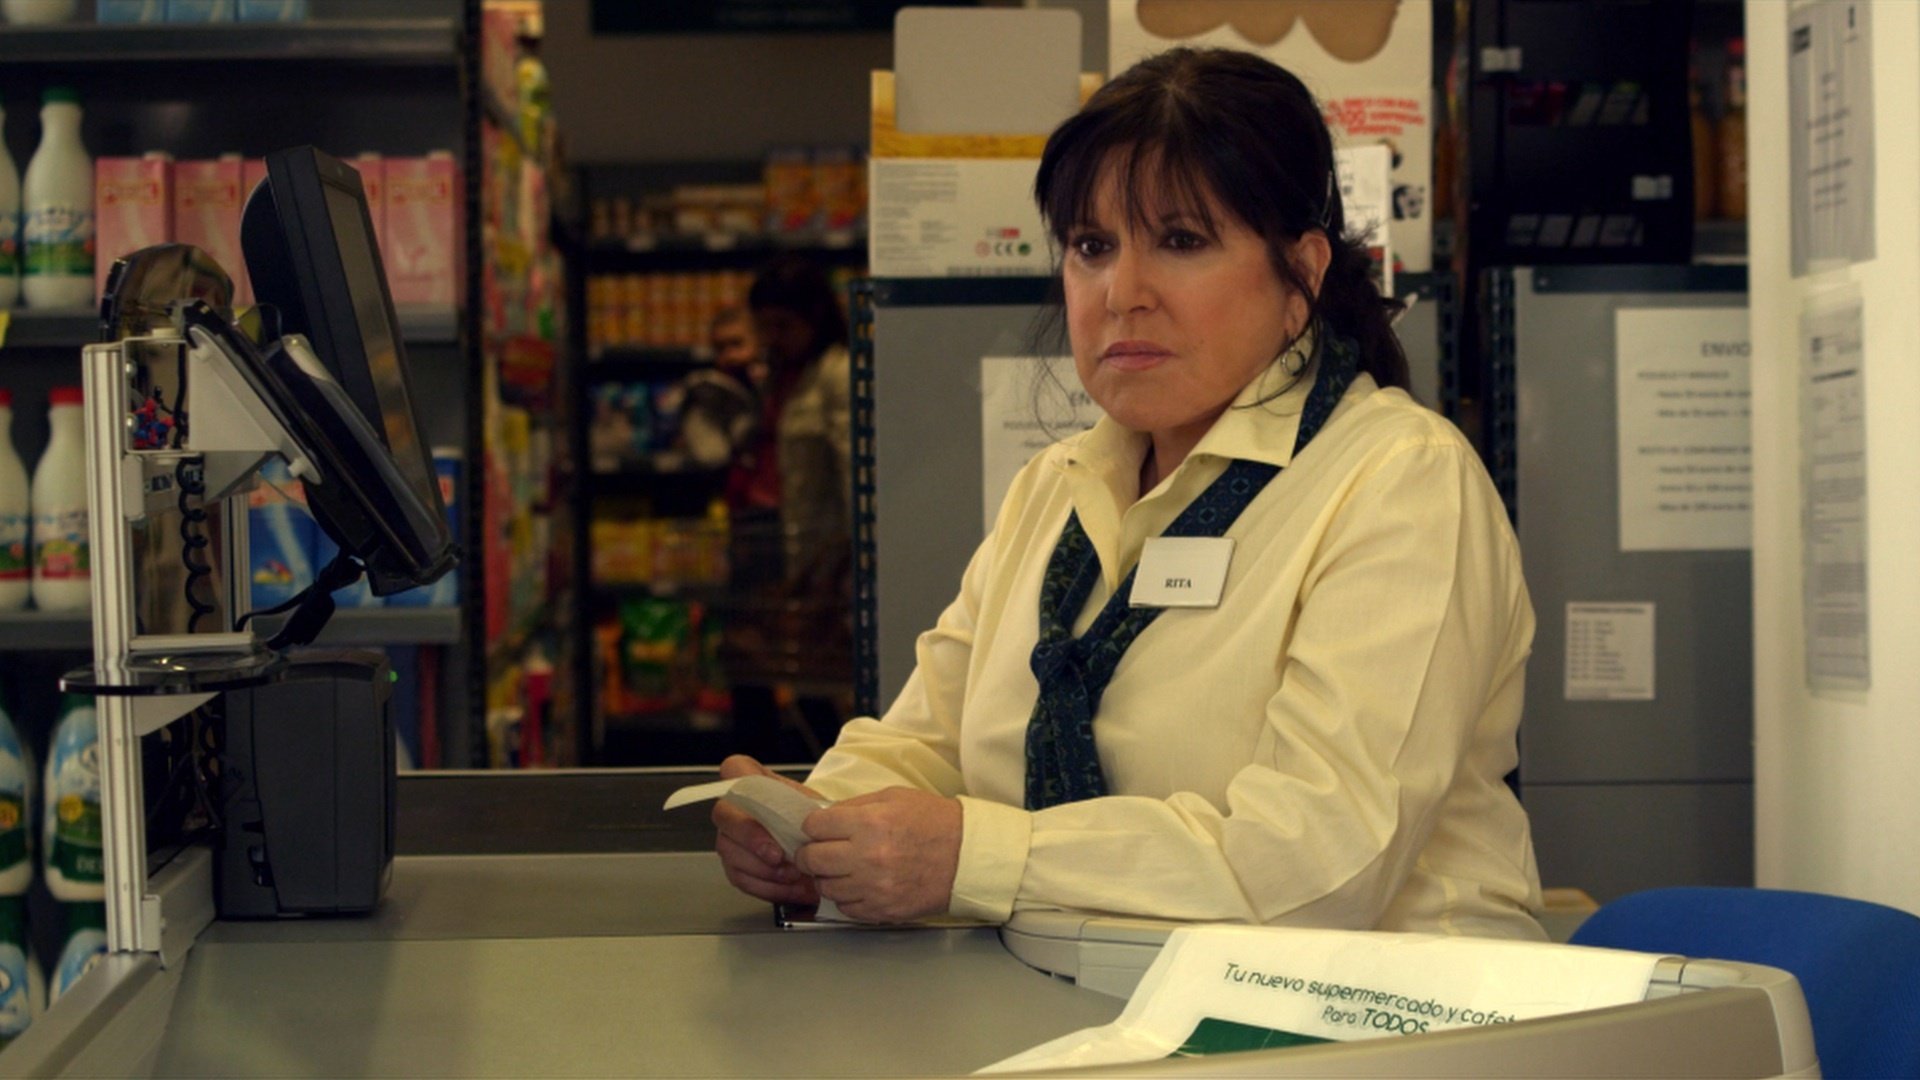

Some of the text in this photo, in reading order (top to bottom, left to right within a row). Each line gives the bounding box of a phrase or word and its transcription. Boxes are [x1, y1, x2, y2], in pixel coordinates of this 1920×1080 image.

[1165, 578, 1192, 589] RITA
[1223, 963, 1247, 982] Tu
[1248, 970, 1304, 992] nuevo
[1308, 981, 1444, 1017] supermercado
[1447, 1006, 1459, 1023] y
[1321, 1005, 1430, 1036] Para TODOS
